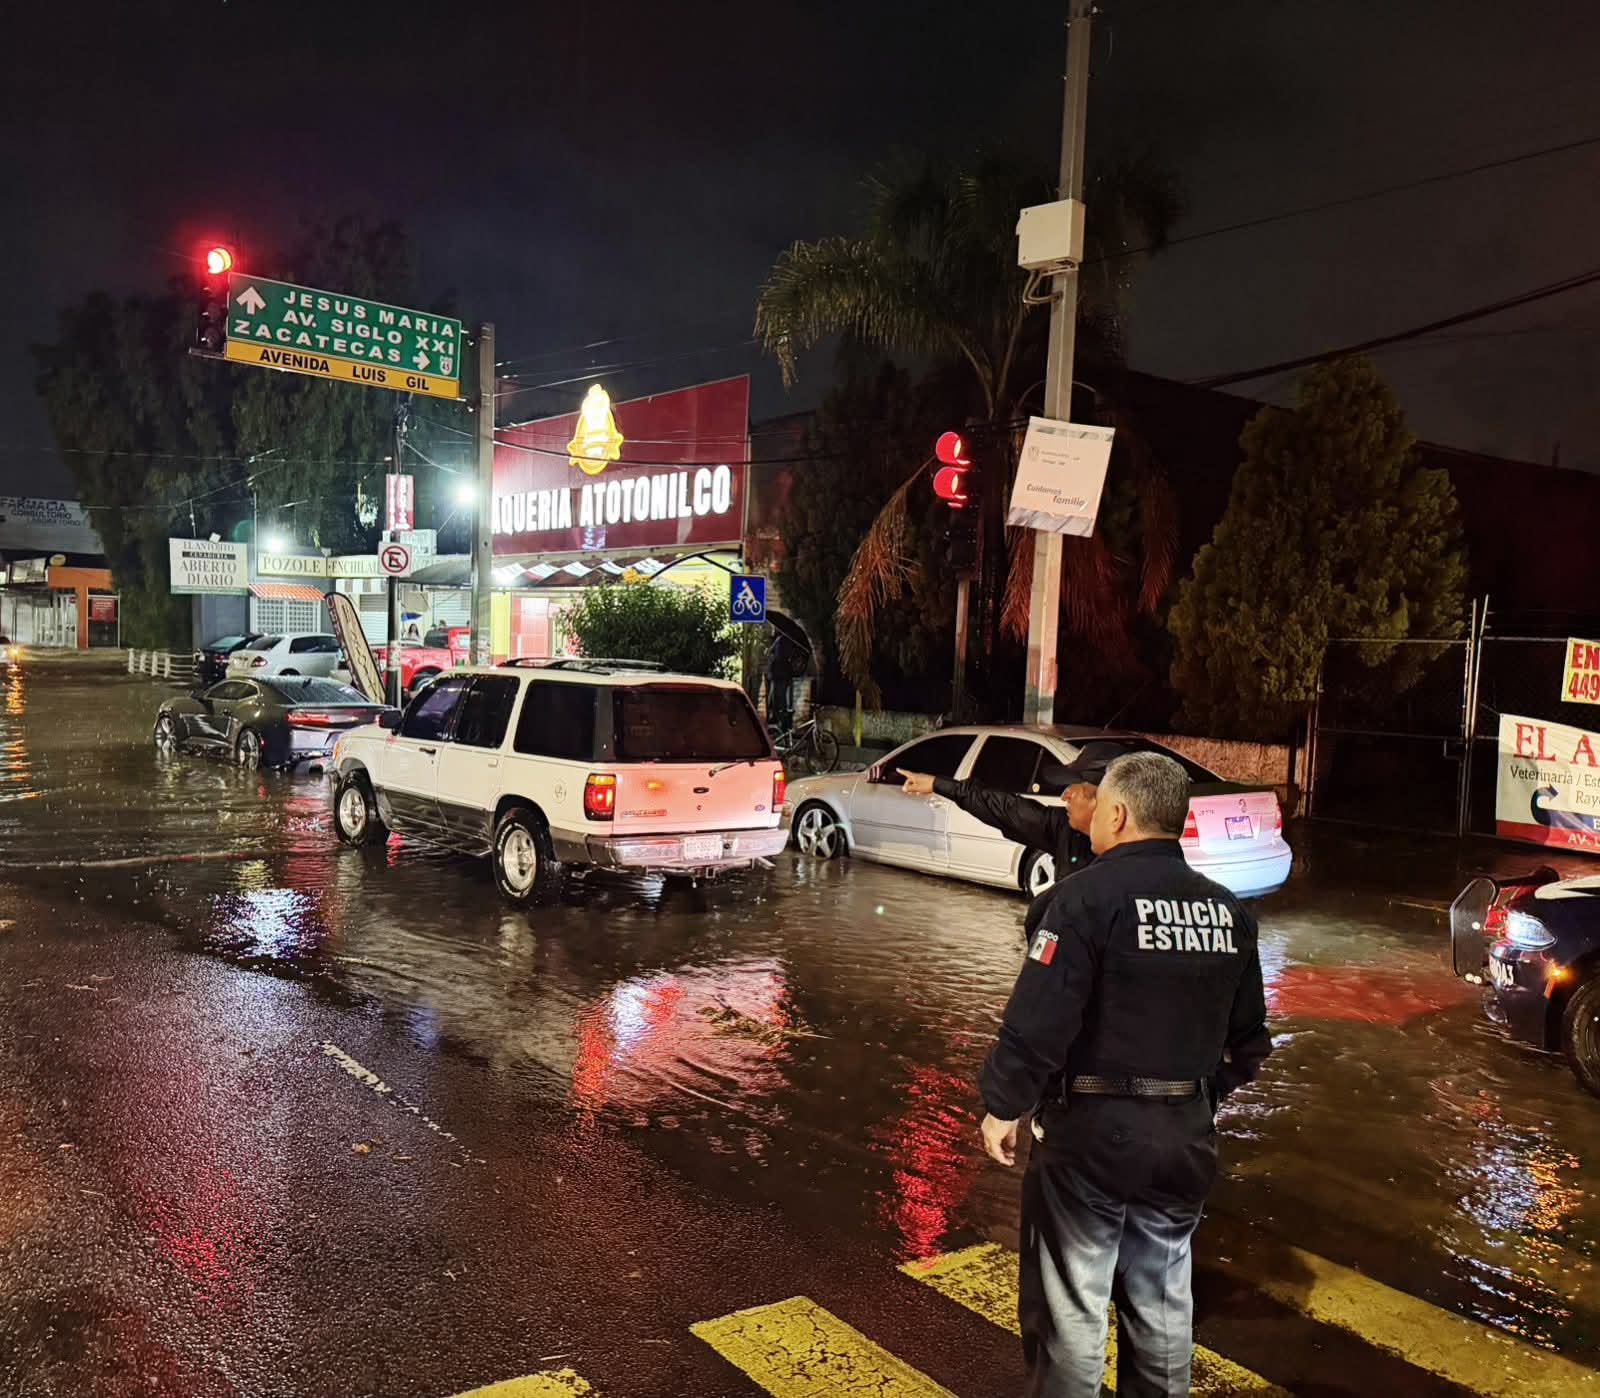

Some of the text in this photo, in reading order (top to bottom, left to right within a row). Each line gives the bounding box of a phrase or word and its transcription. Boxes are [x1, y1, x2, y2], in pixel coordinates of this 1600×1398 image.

[283, 291, 454, 338] JESUS MARIA
[234, 319, 401, 362] ZACATECAS
[283, 310, 454, 355] AV. SIGLO XXI
[260, 349, 429, 390] AVENIDA LUIS GIL
[580, 465, 731, 527] ATOTONILCO
[182, 560, 237, 574] ABIERTO
[187, 573, 233, 586] DIARIO
[263, 556, 321, 573] POZOLE
[1513, 723, 1556, 761] EL
[1510, 765, 1573, 785] Veterinaria
[1135, 898, 1234, 928] POLICÍA
[1137, 924, 1239, 954] ESTATAL
